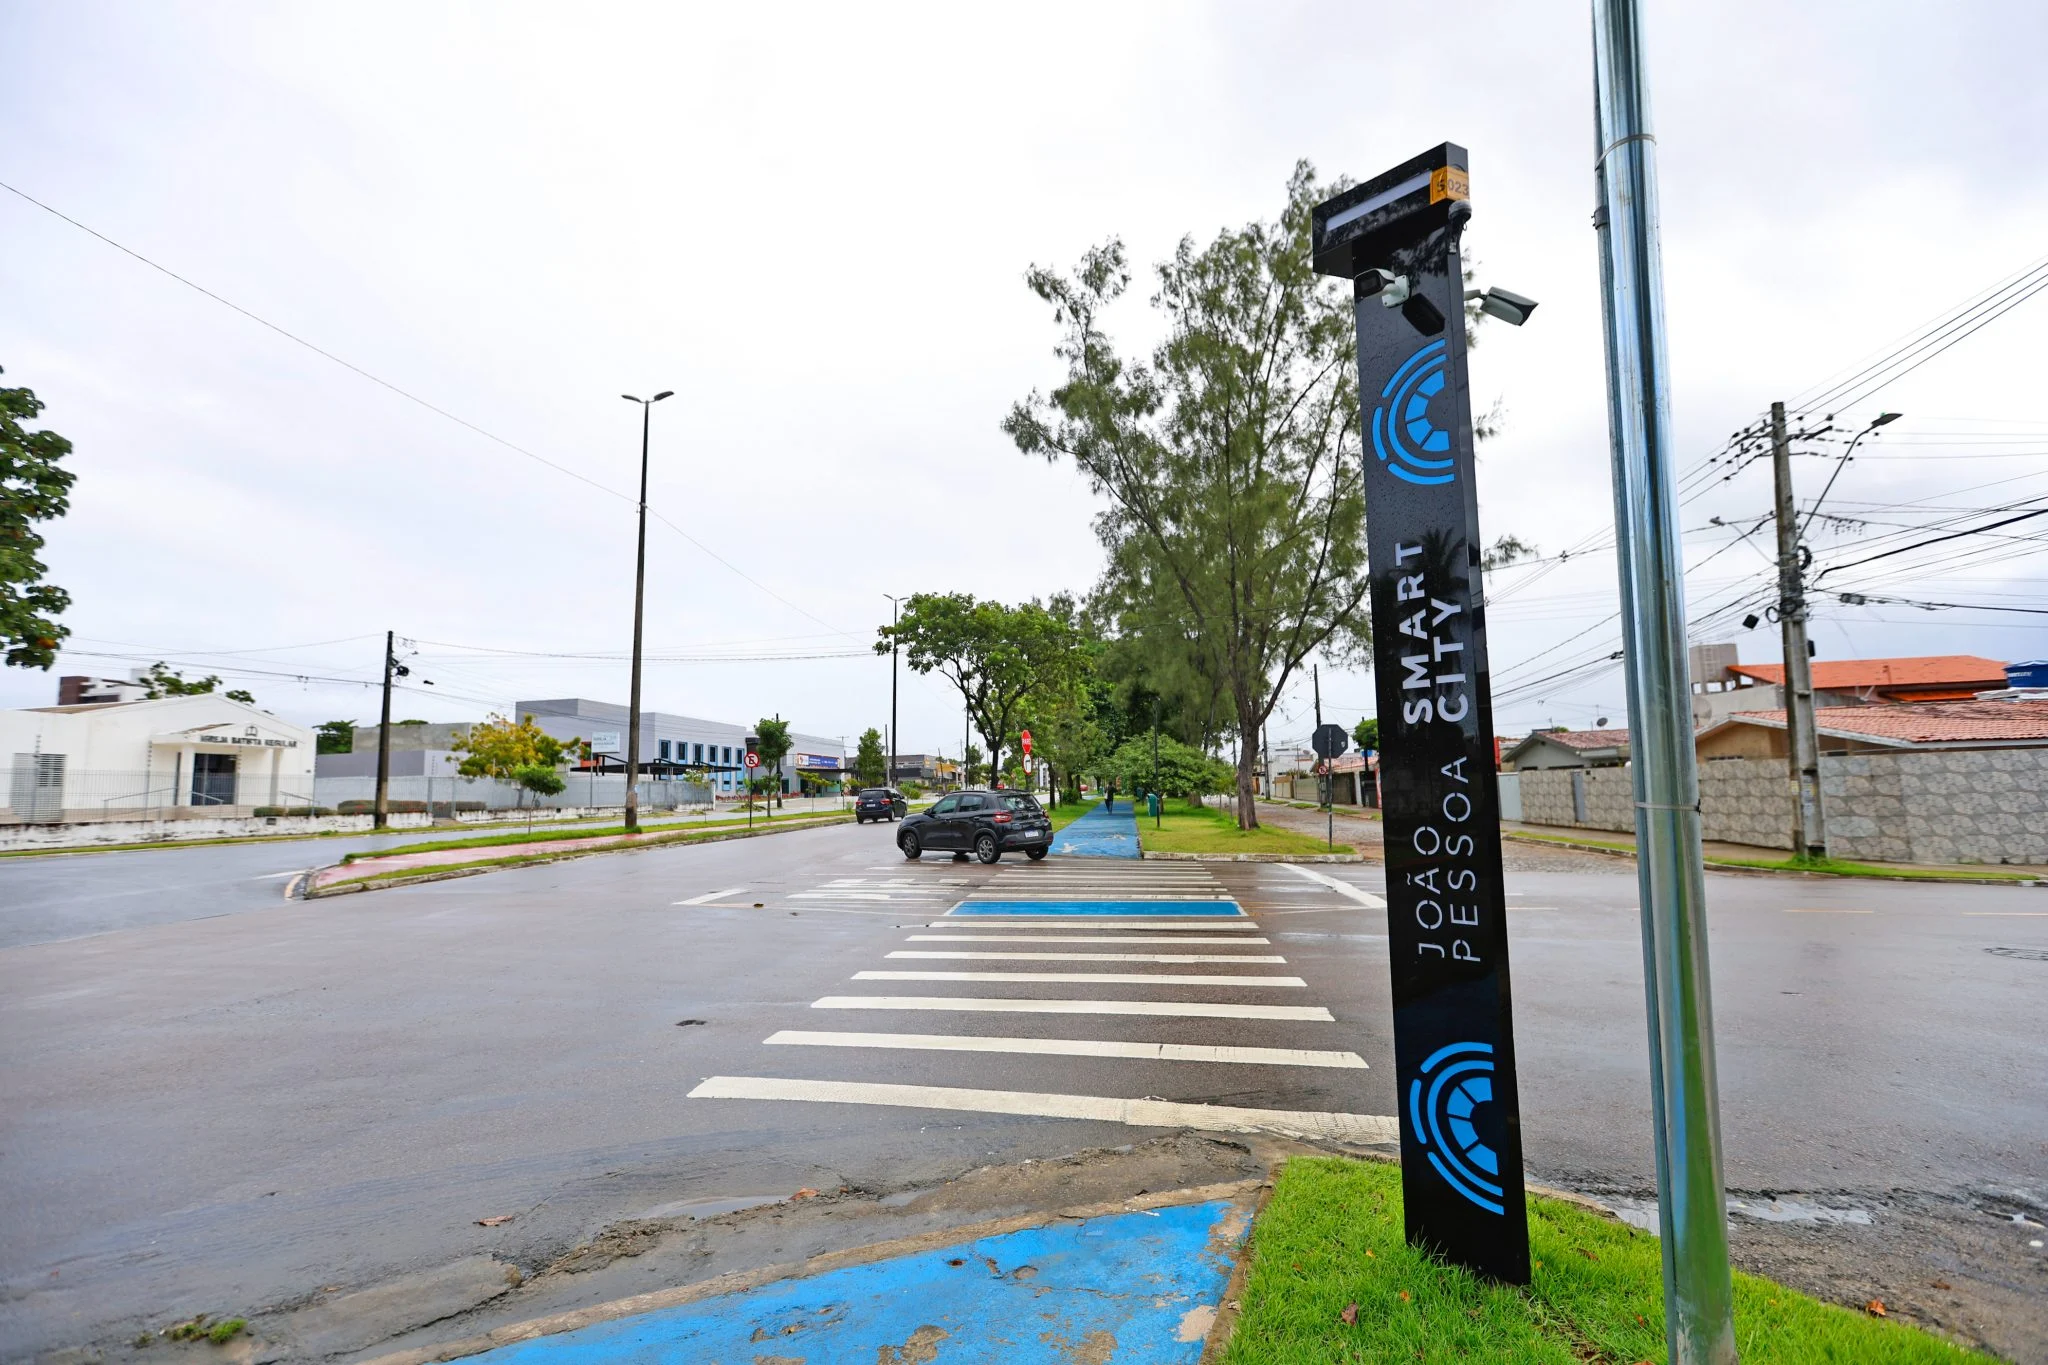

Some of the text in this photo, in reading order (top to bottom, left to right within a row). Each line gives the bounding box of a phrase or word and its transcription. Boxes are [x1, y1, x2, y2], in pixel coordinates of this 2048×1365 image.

[1395, 542, 1433, 725] SMART
[1431, 598, 1469, 723] CITY
[1406, 826, 1445, 959] JOÃO
[1440, 756, 1481, 962] PESSOA
